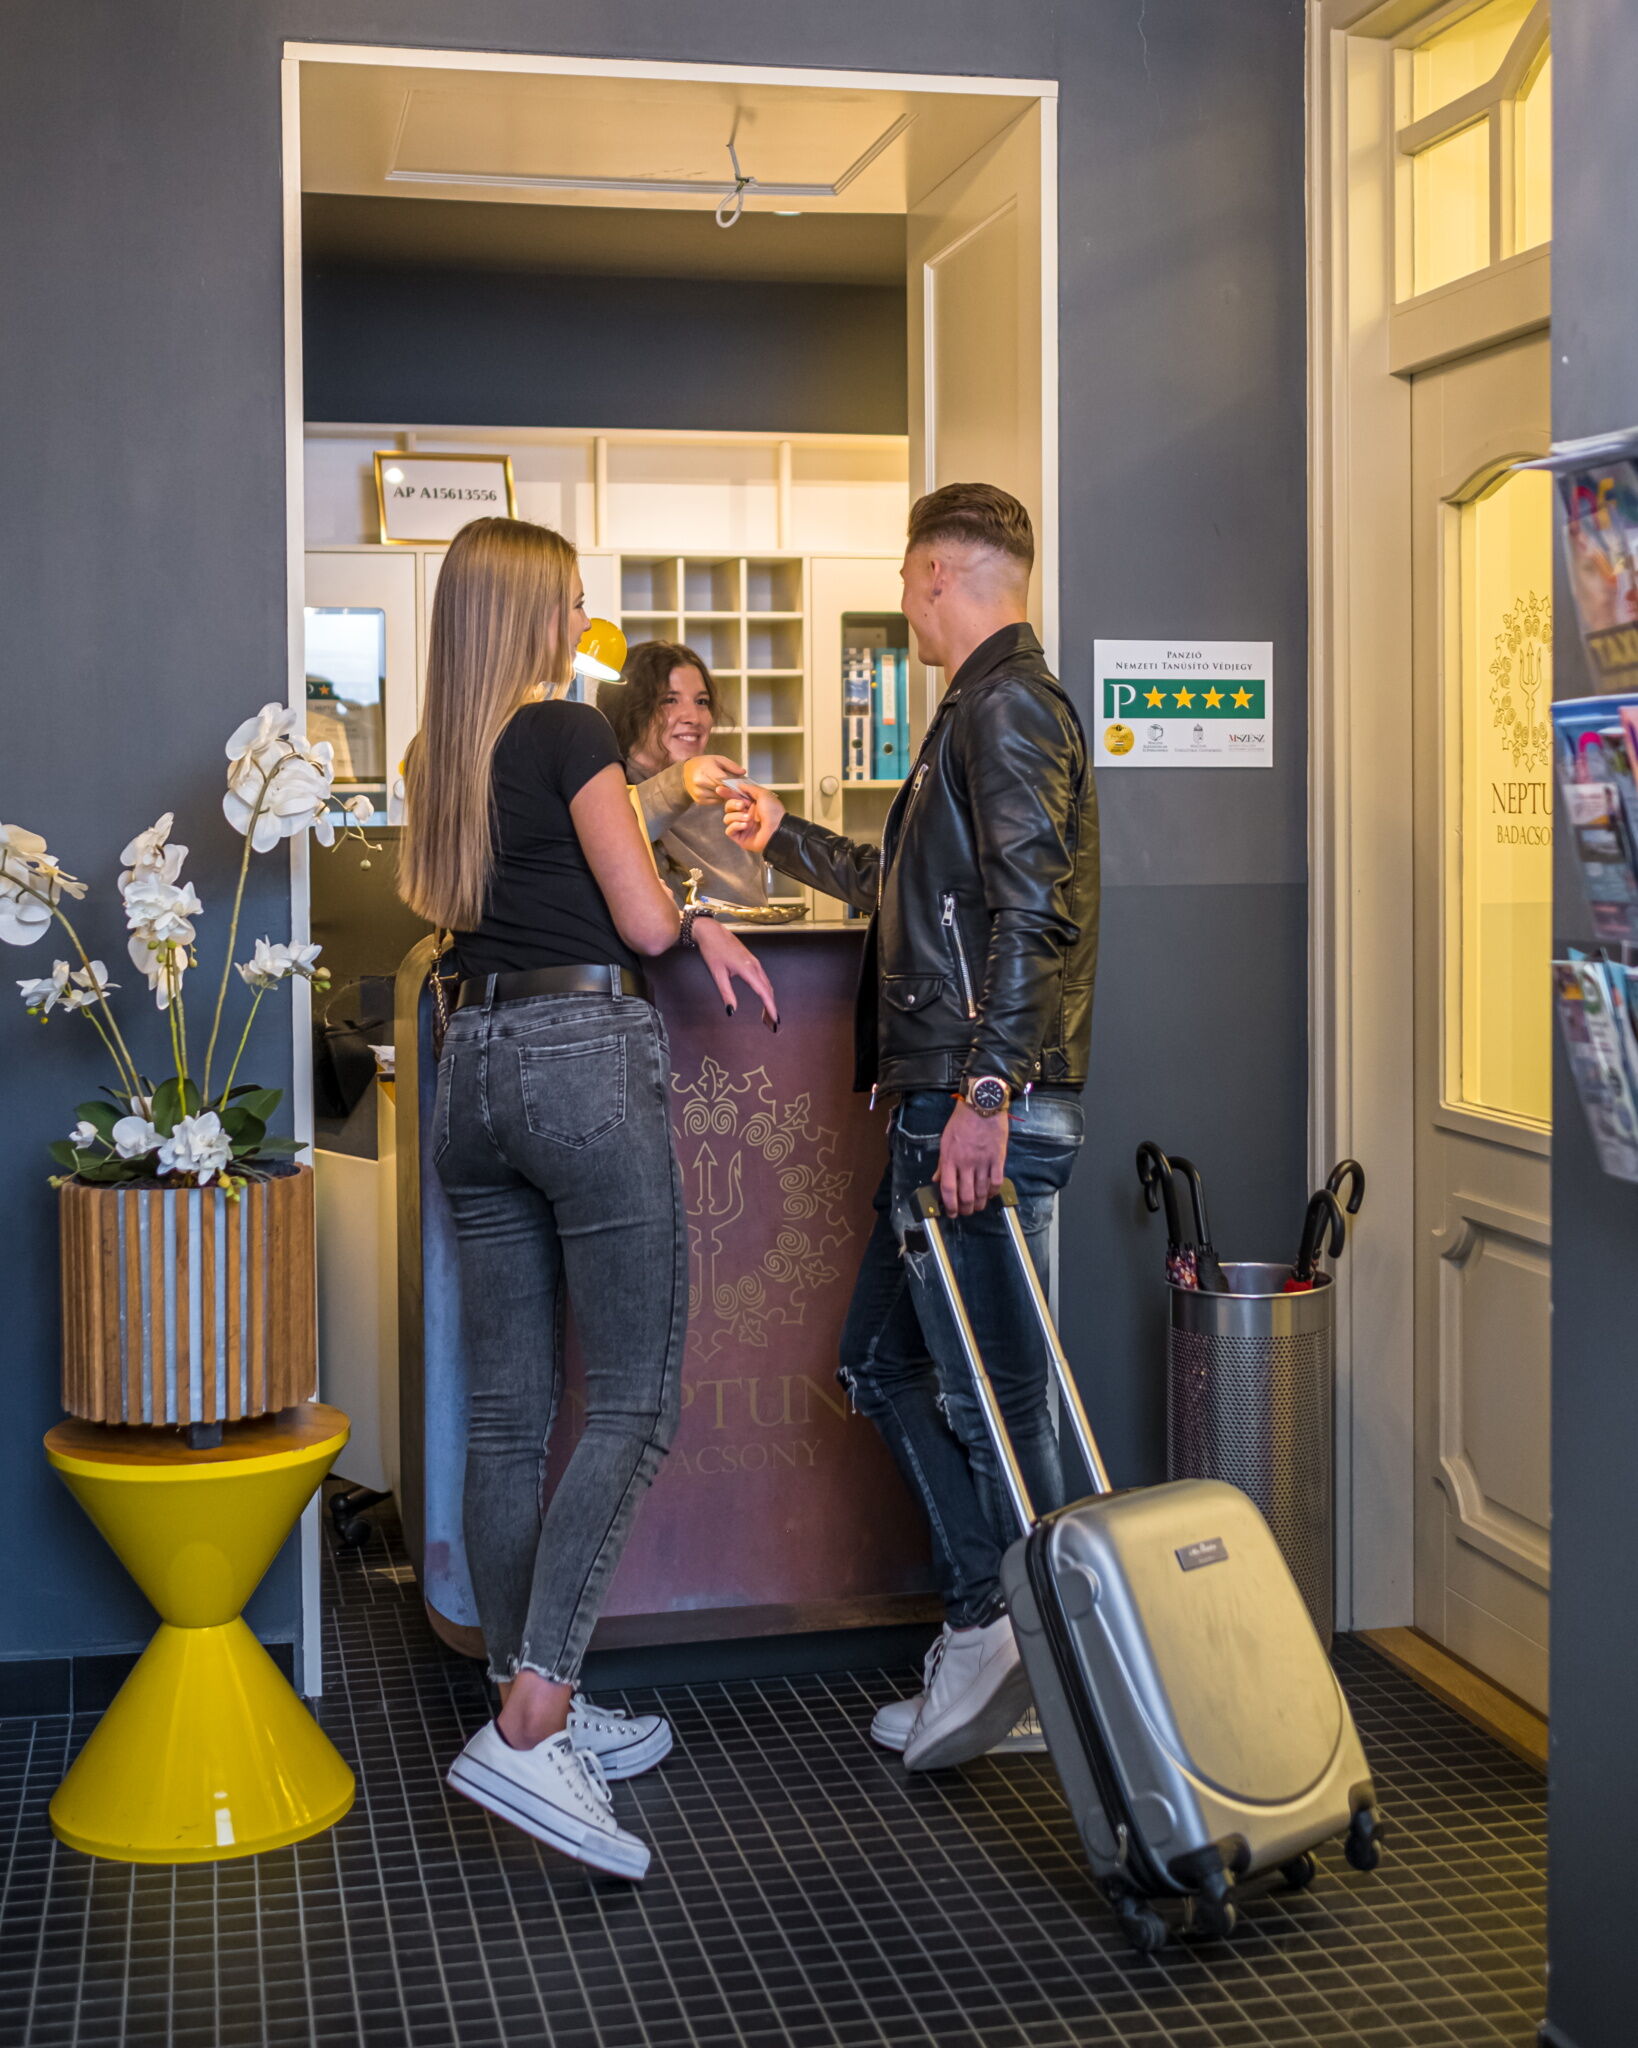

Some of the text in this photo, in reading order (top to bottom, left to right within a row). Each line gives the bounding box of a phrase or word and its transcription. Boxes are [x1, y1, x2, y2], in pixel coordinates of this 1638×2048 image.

[394, 486, 497, 501] AP A15613556
[1115, 661, 1158, 670] NEMZETI
[1110, 684, 1136, 718] P
[1491, 782, 1553, 815] NEPTU
[1497, 825, 1553, 846] BADACSO
[660, 1439, 822, 1476] ACSONY
